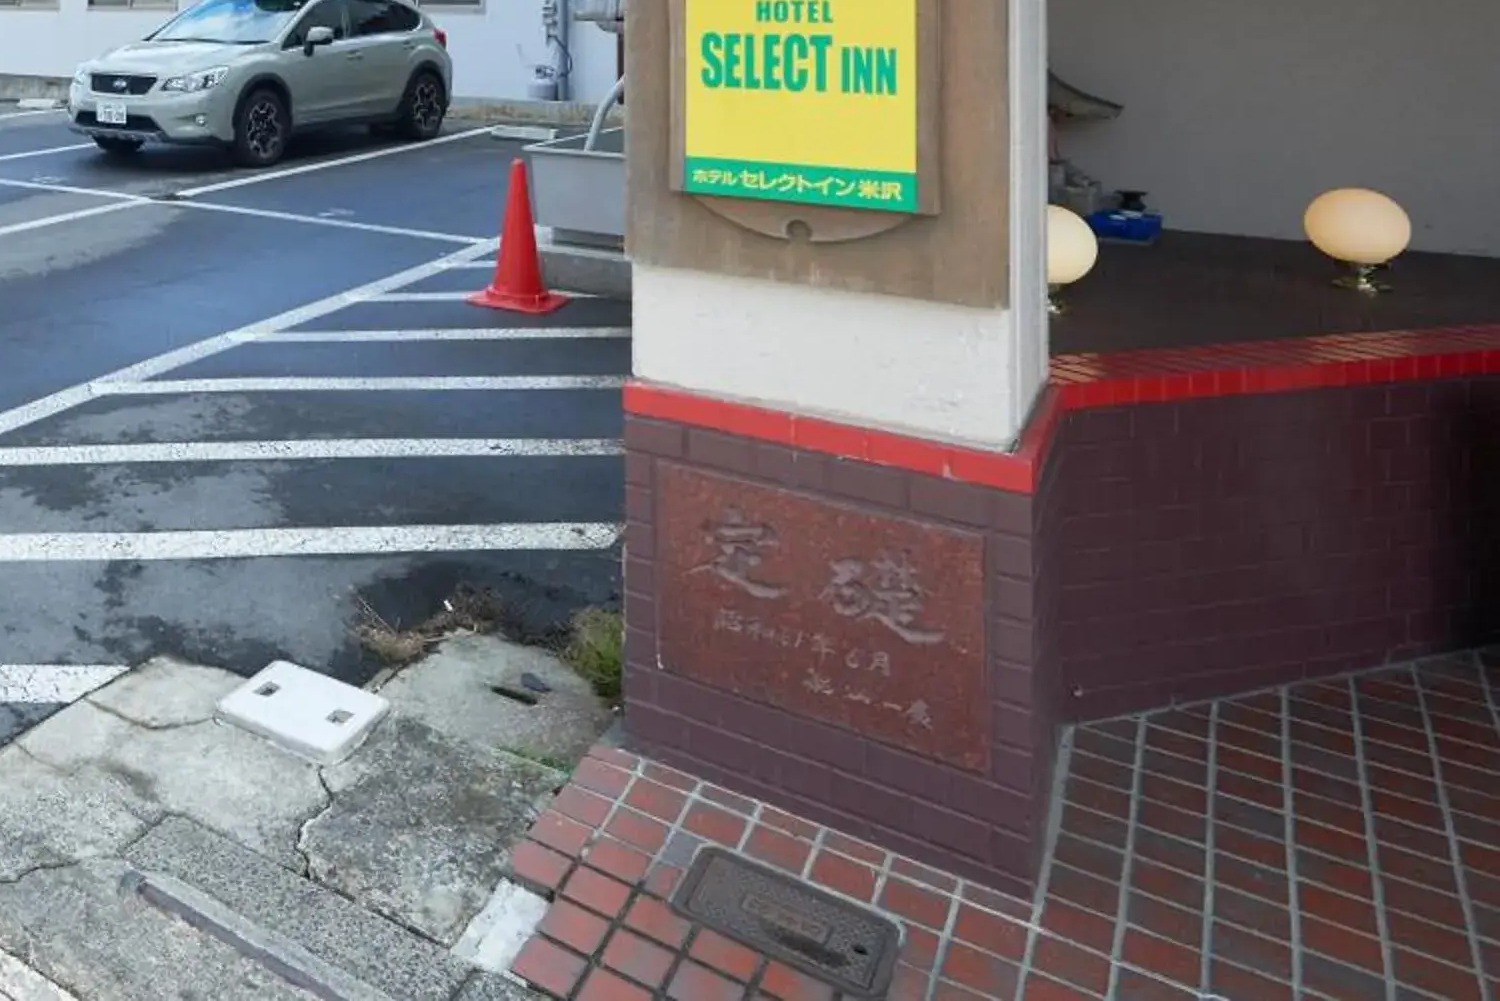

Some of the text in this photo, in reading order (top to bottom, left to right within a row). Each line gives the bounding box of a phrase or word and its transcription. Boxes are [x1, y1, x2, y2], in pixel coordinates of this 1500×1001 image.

[756, 0, 832, 23] HOTEL
[701, 32, 897, 95] SELECT INN
